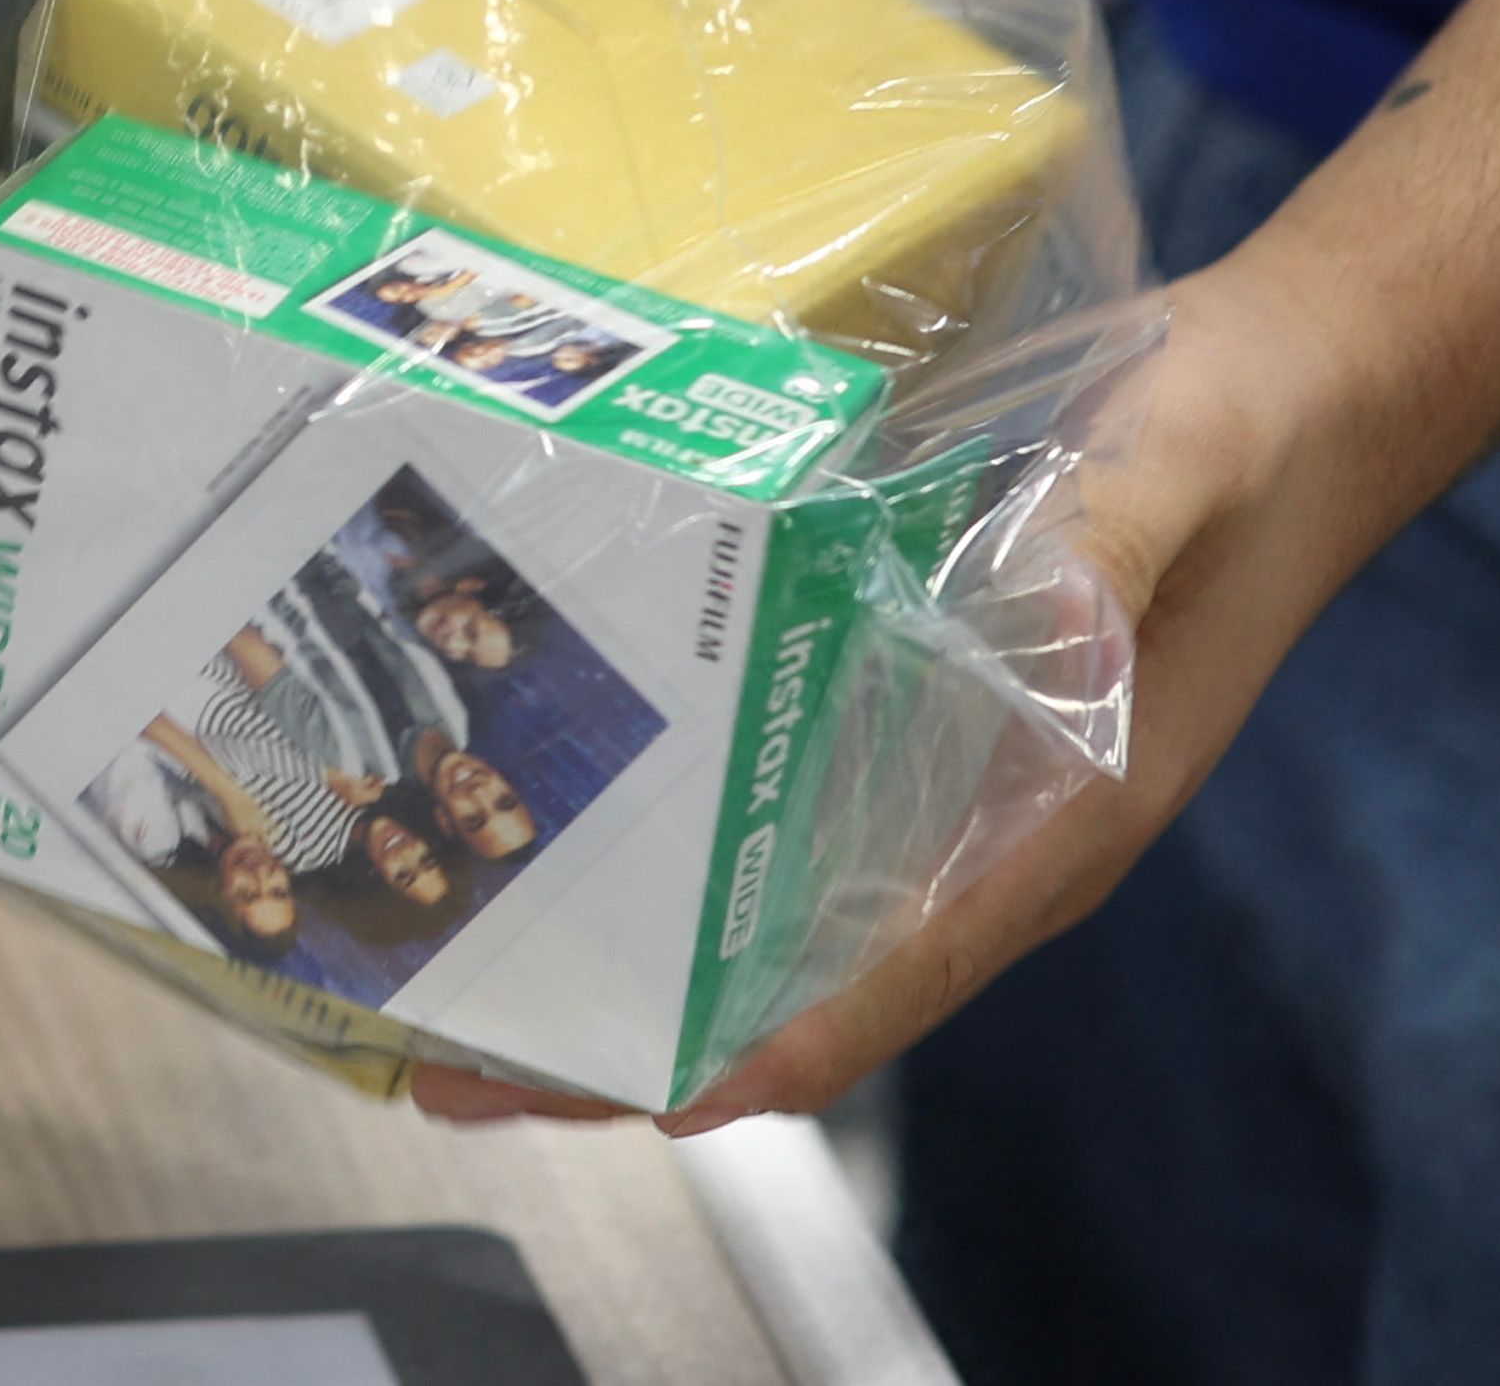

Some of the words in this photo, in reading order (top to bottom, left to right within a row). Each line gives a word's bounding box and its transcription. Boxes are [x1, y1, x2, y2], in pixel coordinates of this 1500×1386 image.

[704, 384, 800, 423] WIDE
[695, 522, 744, 663] FUJIFILM
[746, 616, 833, 816] instax
[0, 799, 41, 860] 20
[724, 831, 770, 954] WIDE
